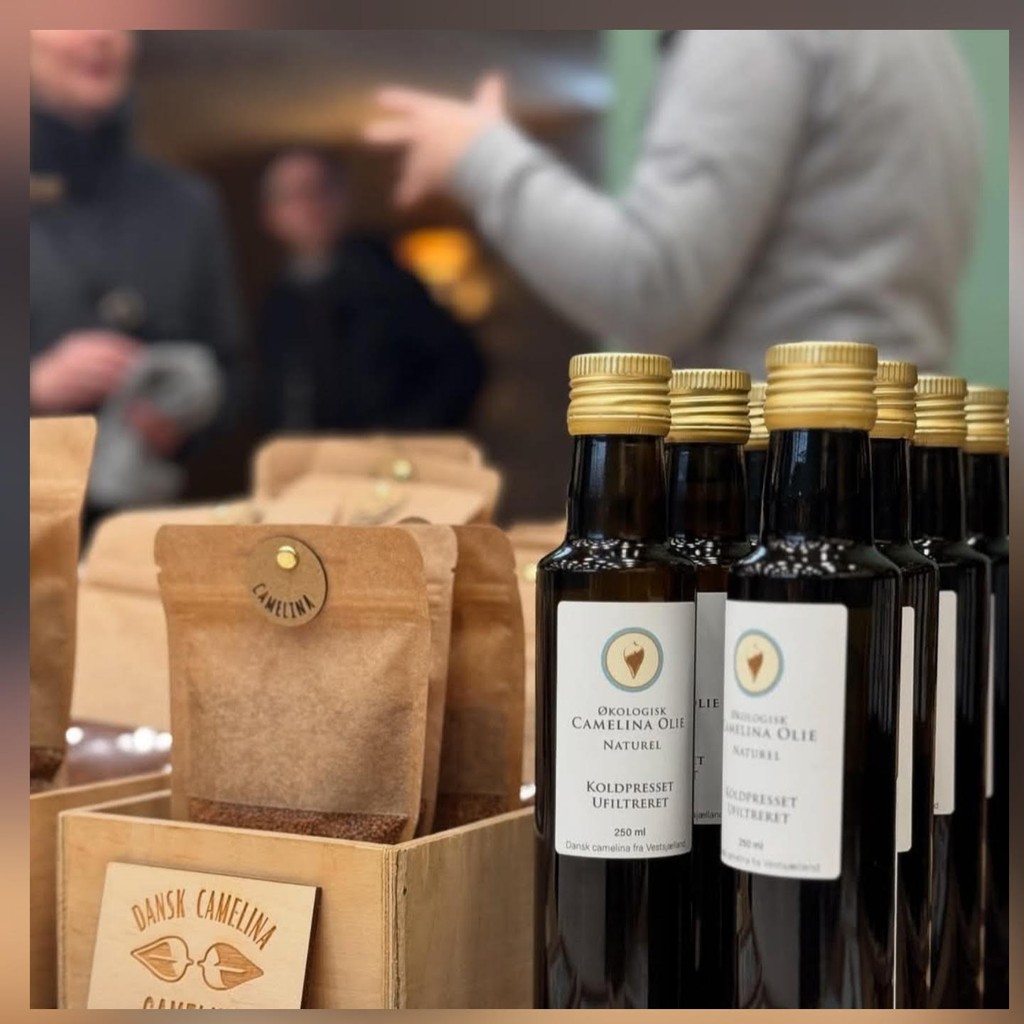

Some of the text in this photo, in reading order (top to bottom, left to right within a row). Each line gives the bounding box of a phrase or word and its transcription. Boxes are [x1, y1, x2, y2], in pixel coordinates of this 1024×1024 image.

[252, 582, 316, 619] CAMELINA
[694, 698, 720, 709] LIE
[597, 705, 668, 717] ØKOLOGISK
[571, 716, 686, 731] CAMELINA OLIE
[724, 722, 818, 743] AMELINA OLIE
[603, 740, 662, 751] NATUREL
[586, 780, 674, 794] KOLDPRESSET
[592, 796, 670, 809] UFILTRERET
[614, 827, 646, 838] 250 ml
[565, 840, 591, 852] Dansk
[592, 843, 631, 853] camelina
[633, 843, 644, 853] fra
[131, 888, 278, 951] DANSK CAMELINA
